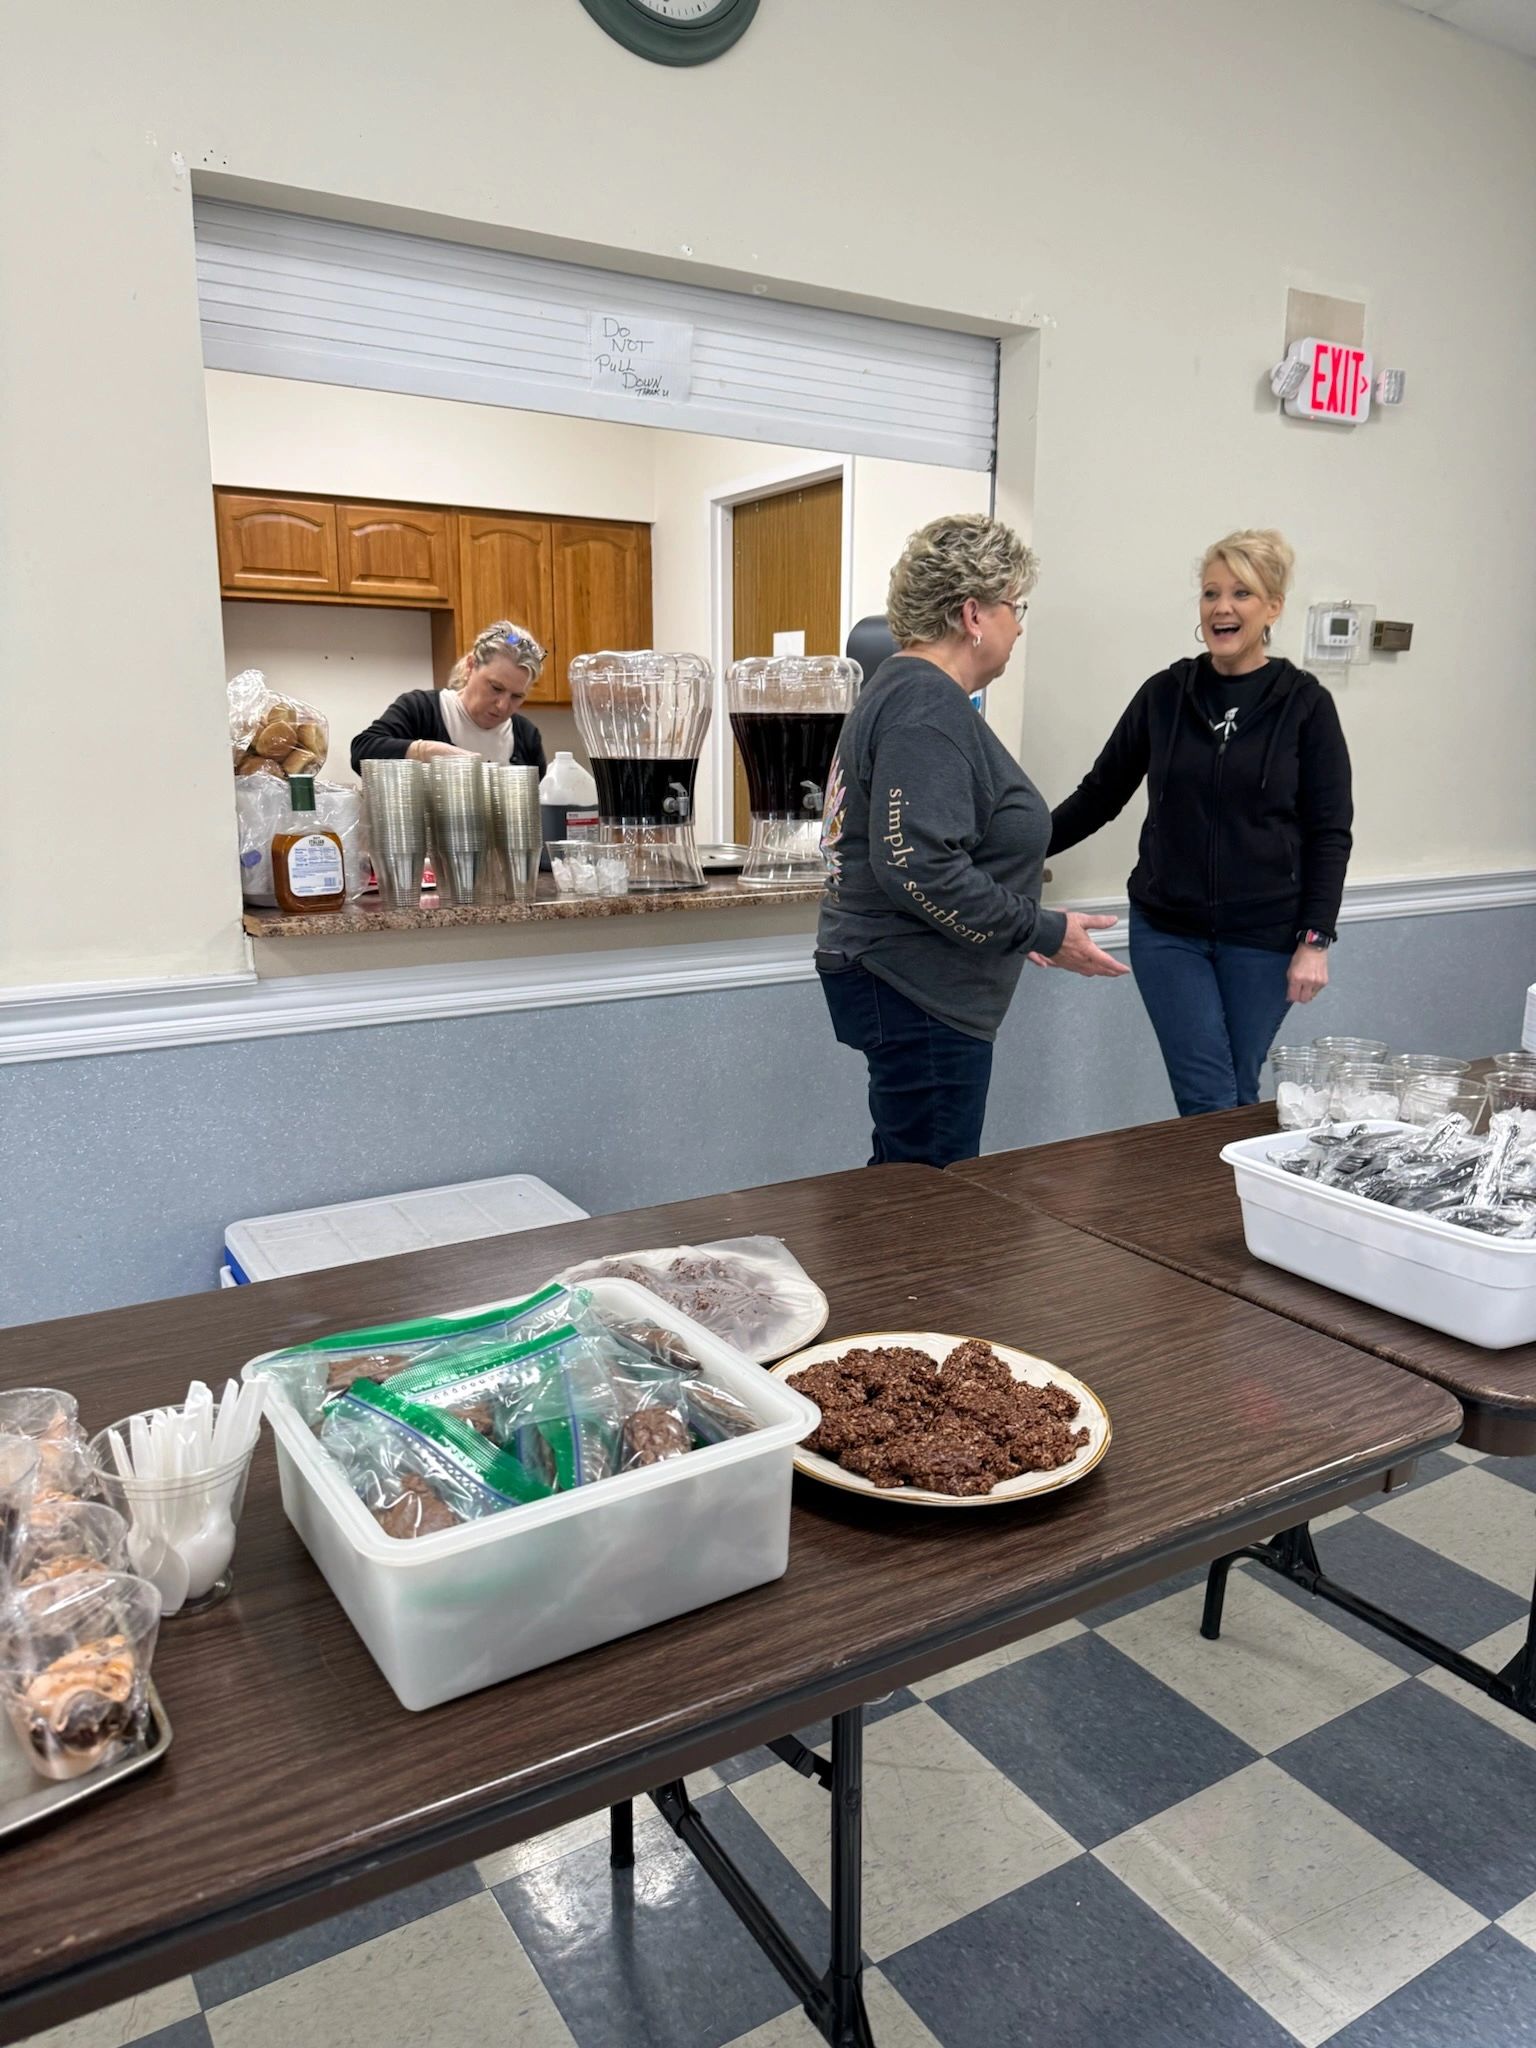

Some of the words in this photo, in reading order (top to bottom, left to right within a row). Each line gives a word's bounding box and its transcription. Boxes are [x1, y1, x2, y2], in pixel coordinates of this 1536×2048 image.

[612, 338, 654, 352] NOT
[1311, 344, 1364, 416] EXIT
[884, 788, 914, 869] simply
